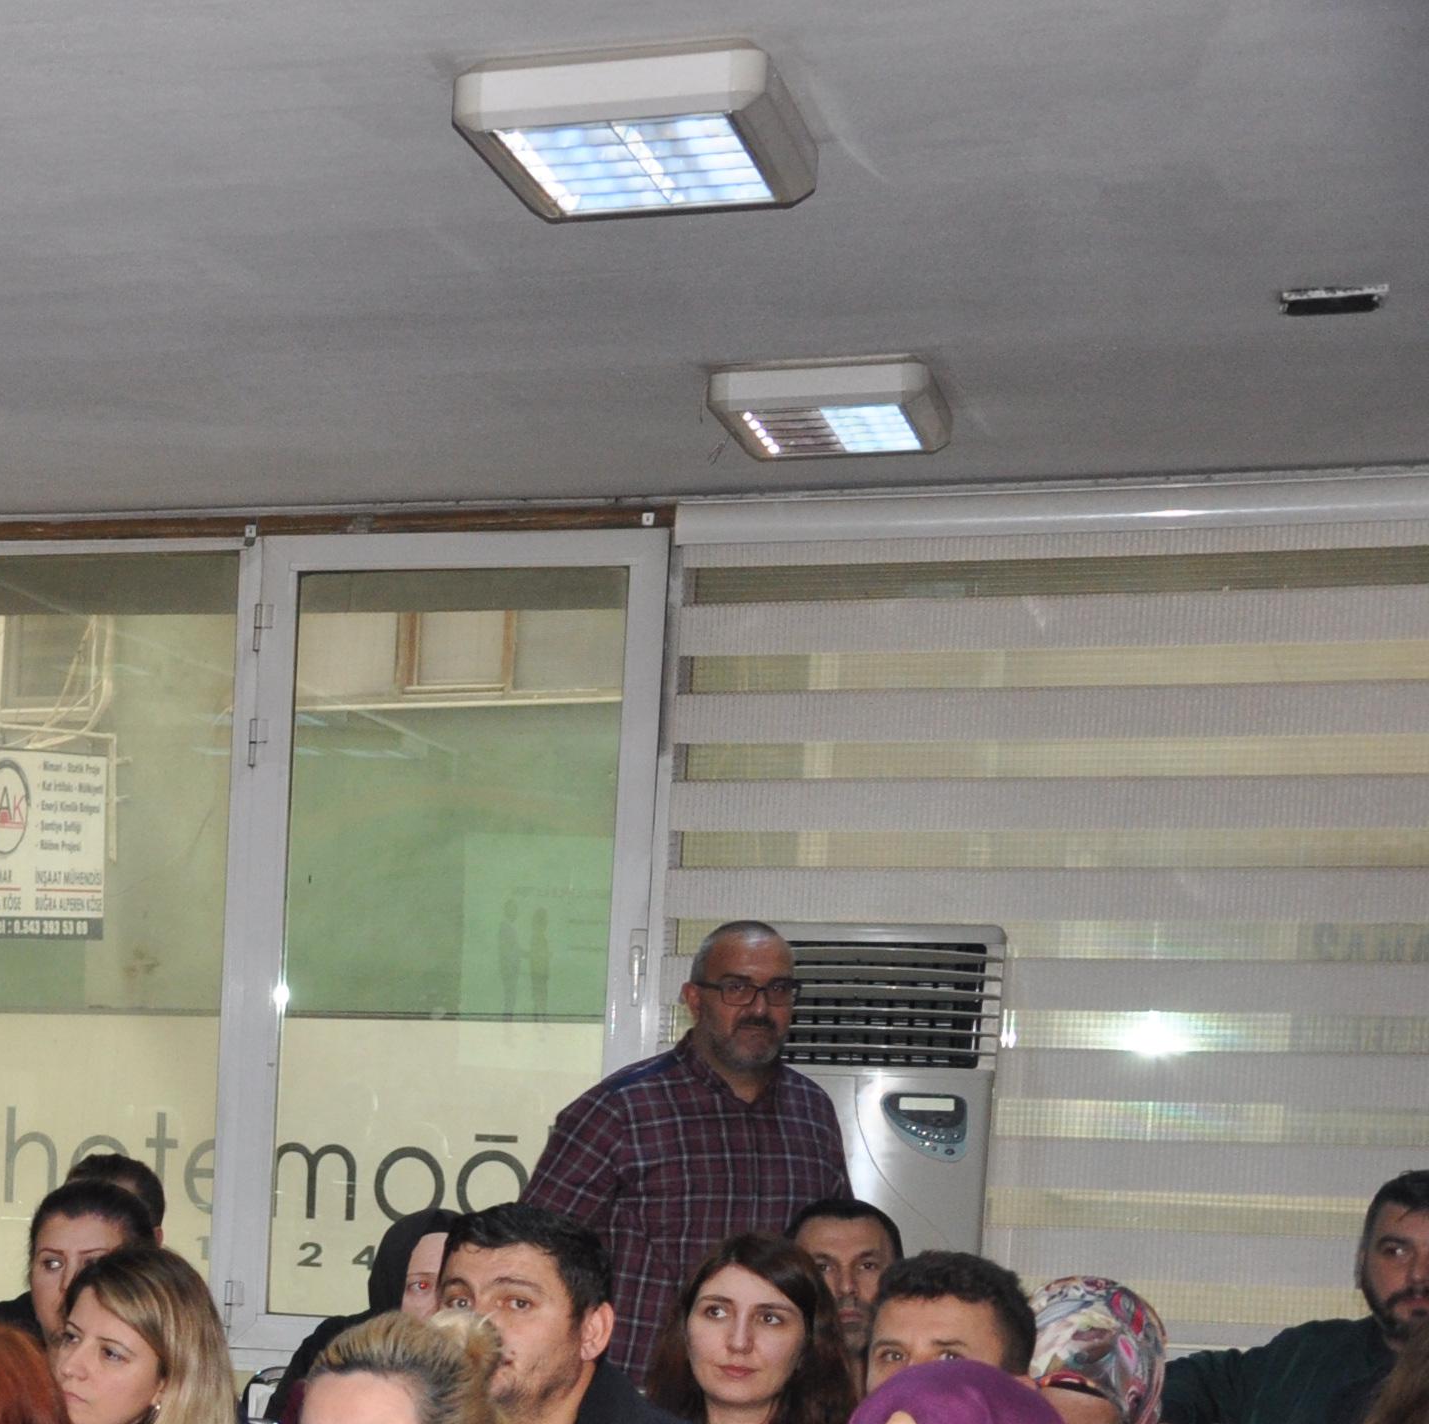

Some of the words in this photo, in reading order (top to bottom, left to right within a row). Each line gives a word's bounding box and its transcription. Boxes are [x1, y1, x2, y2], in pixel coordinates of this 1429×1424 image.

[35, 866, 61, 887] İNŞAAT
[3, 893, 21, 911] KÖSE
[35, 894, 57, 911] BUĞRA
[86, 895, 102, 912] KÖSE
